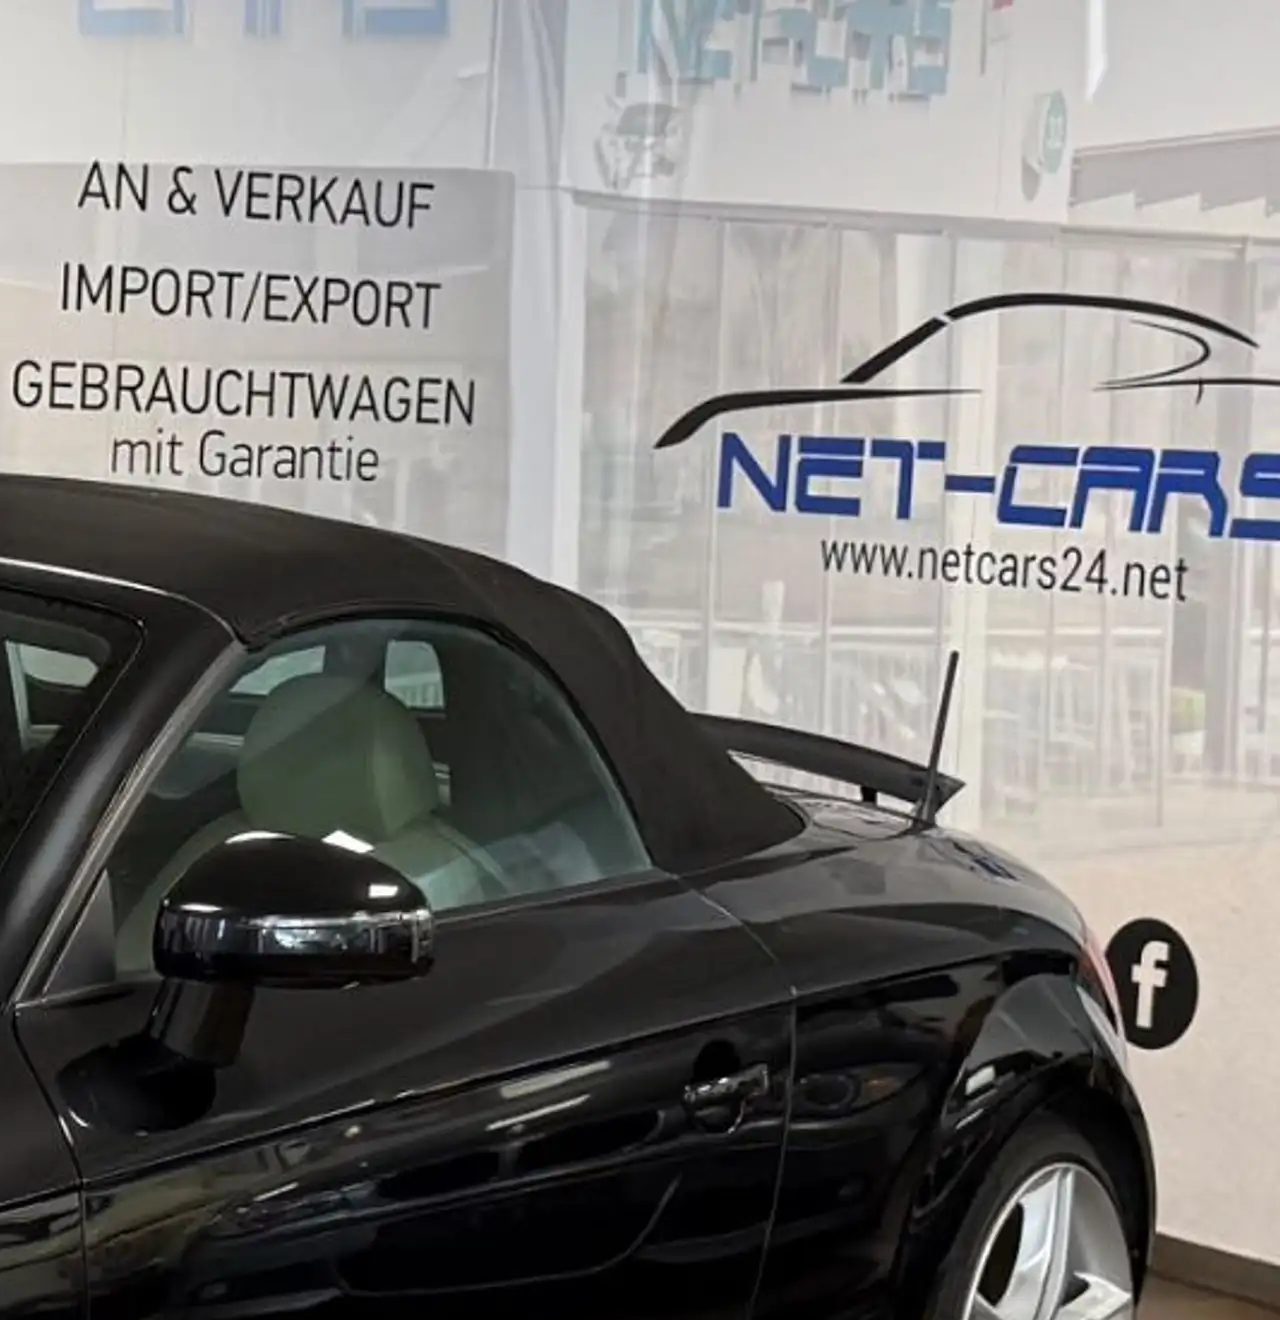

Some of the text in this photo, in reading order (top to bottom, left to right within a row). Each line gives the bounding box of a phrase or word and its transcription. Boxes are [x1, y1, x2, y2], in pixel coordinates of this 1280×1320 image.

[77, 161, 435, 229] AN & VERKAUF
[61, 262, 441, 329] IMPORT/EXPORT
[12, 359, 476, 426] GEBRAUCHTWAGEN
[111, 429, 380, 483] mit Garantie
[717, 432, 1280, 540] NET-CARS
[820, 539, 1189, 602] www.netcars24.net
